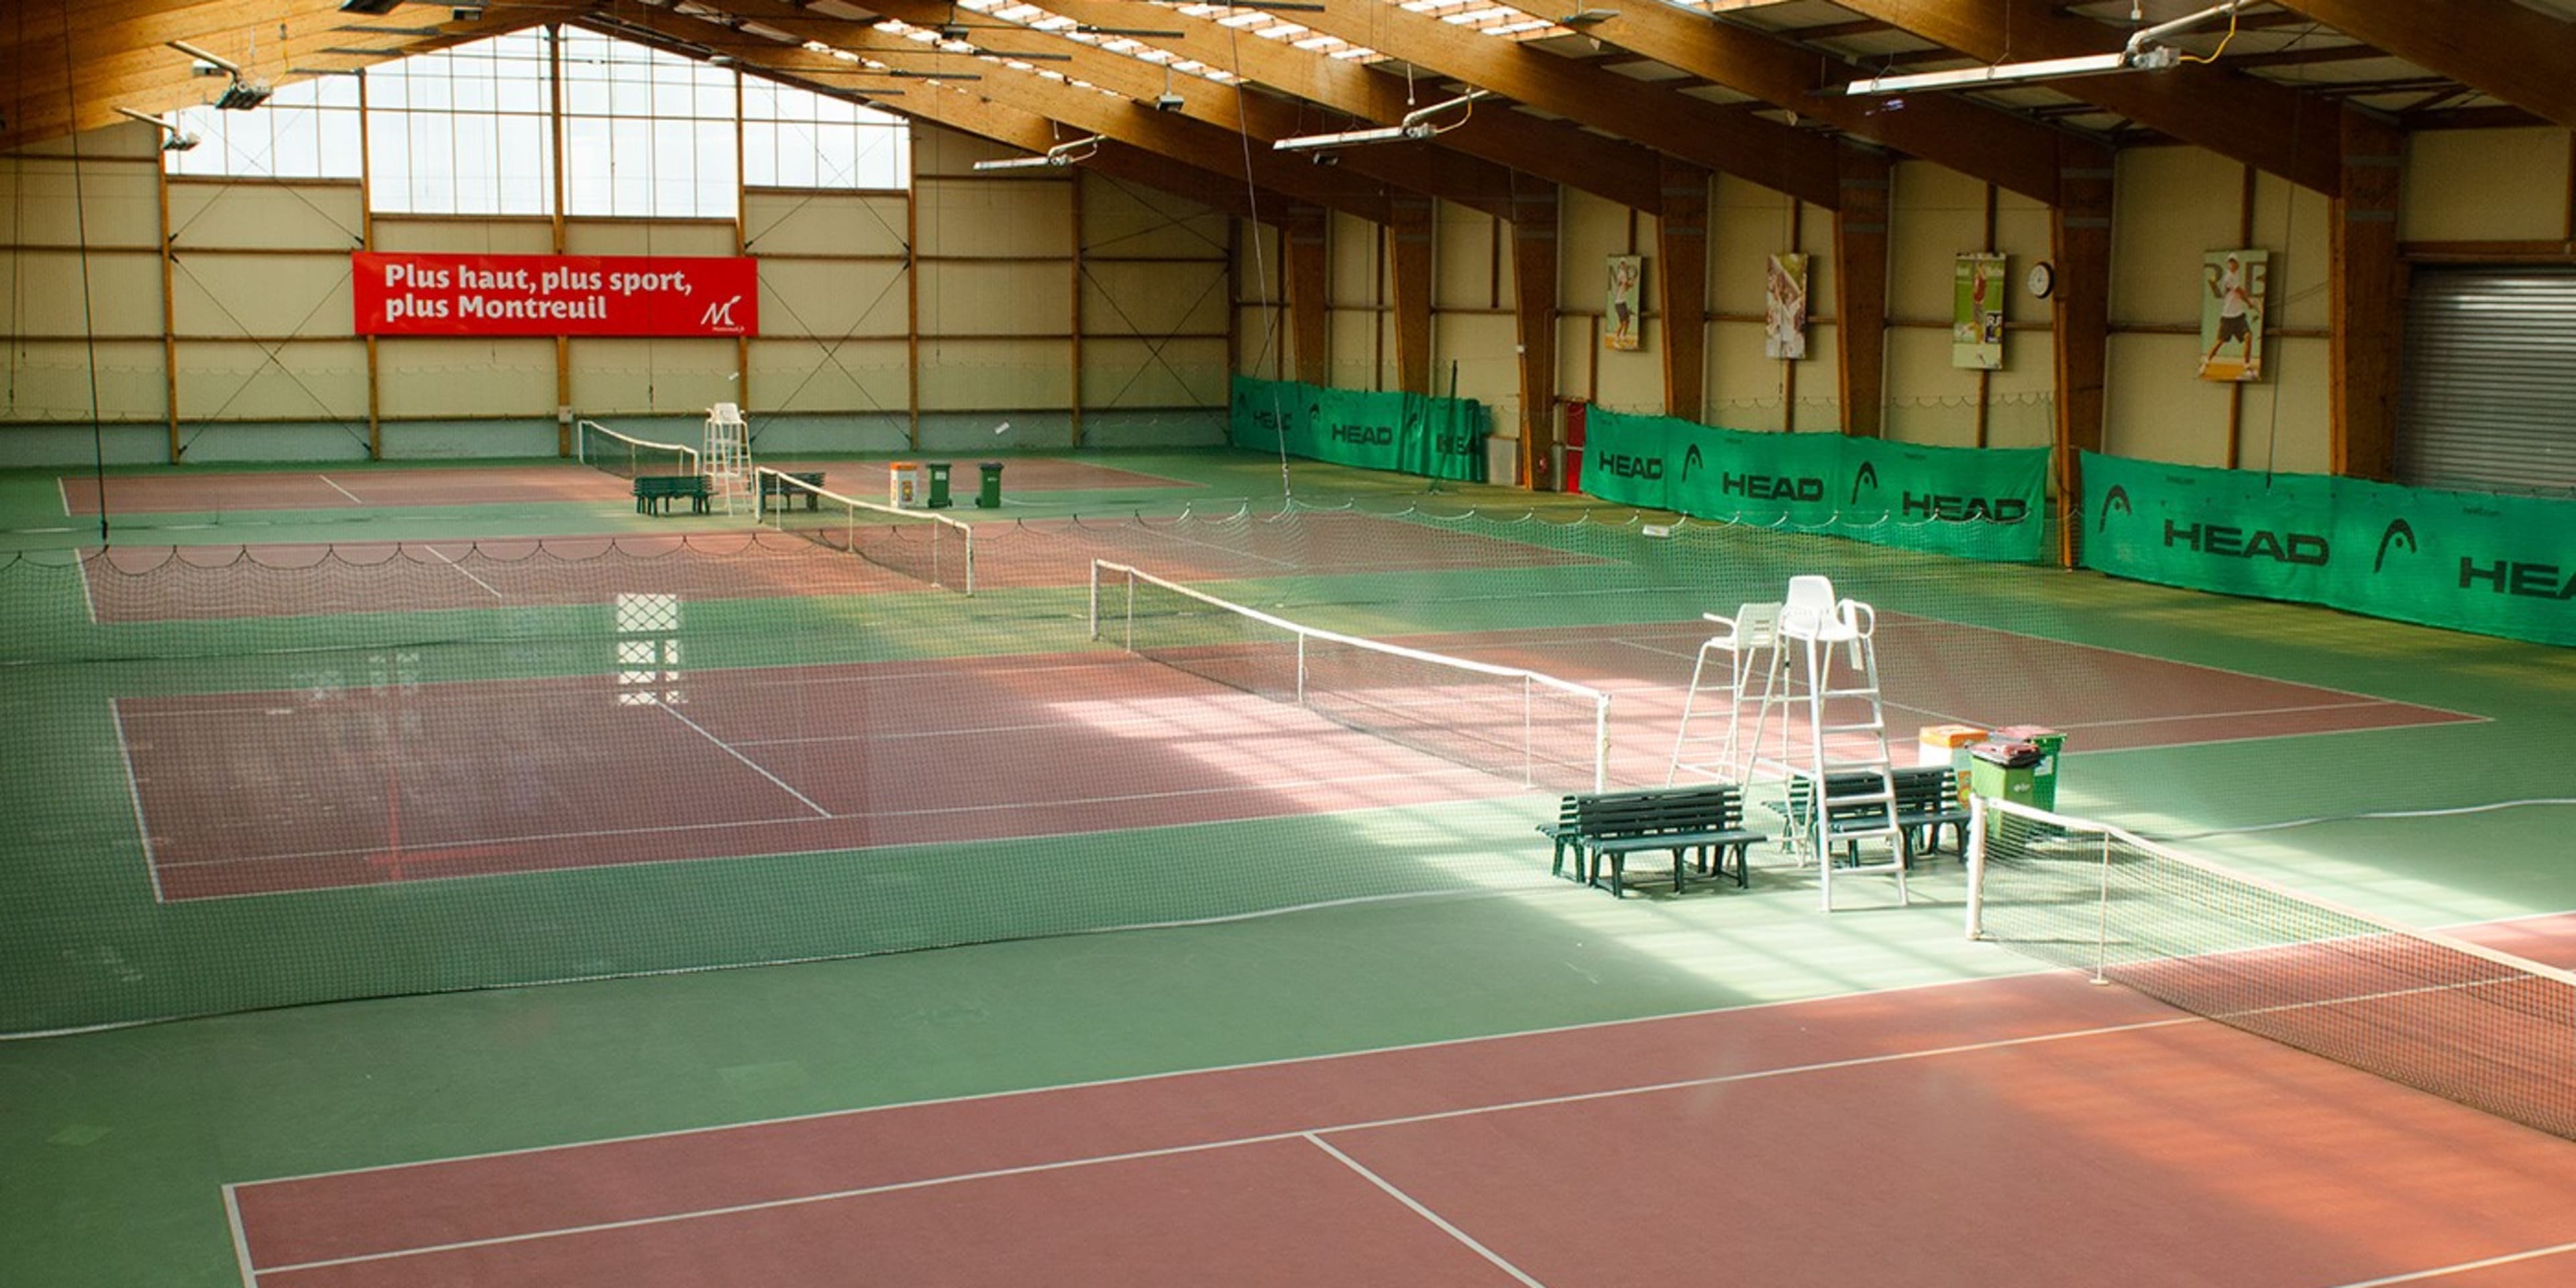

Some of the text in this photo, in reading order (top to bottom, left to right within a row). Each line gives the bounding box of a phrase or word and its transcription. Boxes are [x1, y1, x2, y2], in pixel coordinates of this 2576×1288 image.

[385, 263, 692, 297] Plus haut, plus sport,
[386, 292, 606, 323] plus Montreuil
[1331, 423, 1393, 447] HEAD
[1599, 451, 1663, 480] HEAD
[1722, 472, 1824, 502] HEAD
[1902, 490, 2027, 524] HEAD
[2164, 519, 2330, 567] HEAD
